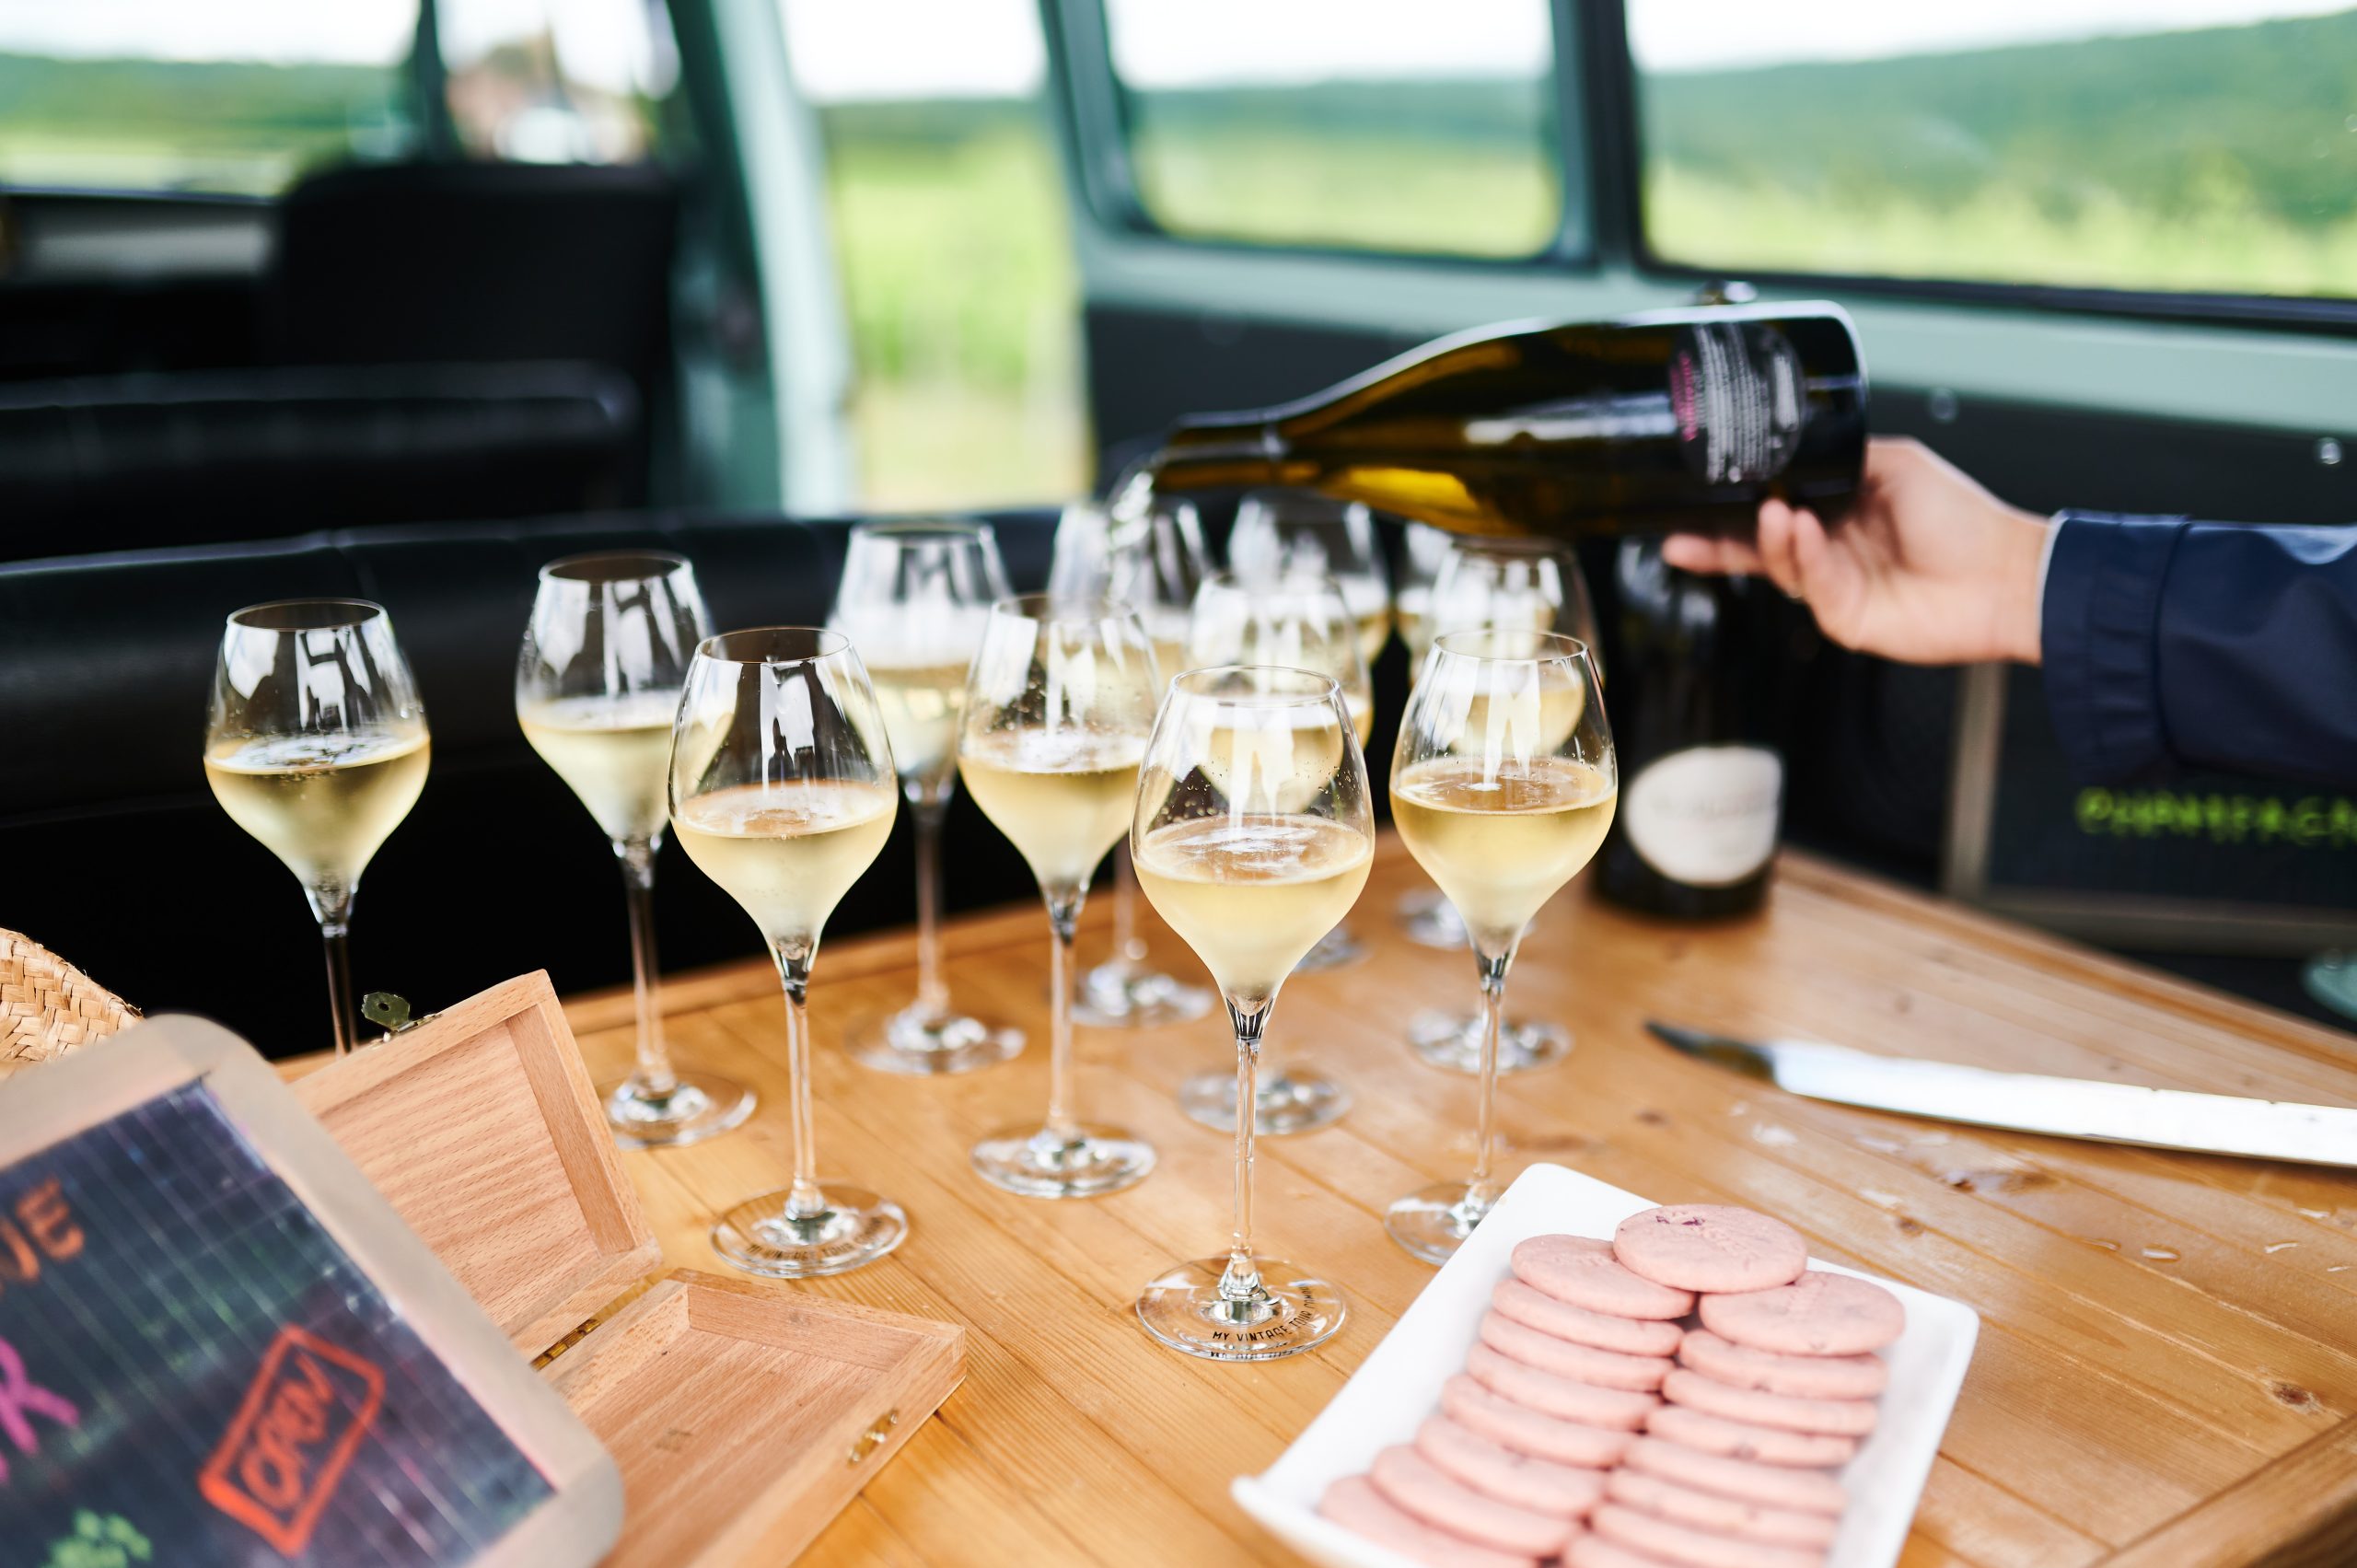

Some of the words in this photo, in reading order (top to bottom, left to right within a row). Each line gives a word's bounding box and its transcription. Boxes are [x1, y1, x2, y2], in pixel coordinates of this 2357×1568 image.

[1212, 1330, 1230, 1342] MY
[1237, 1325, 1290, 1342] VINTAGE
[1289, 1310, 1312, 1329] TOUR
[240, 1351, 334, 1510] OPEN
